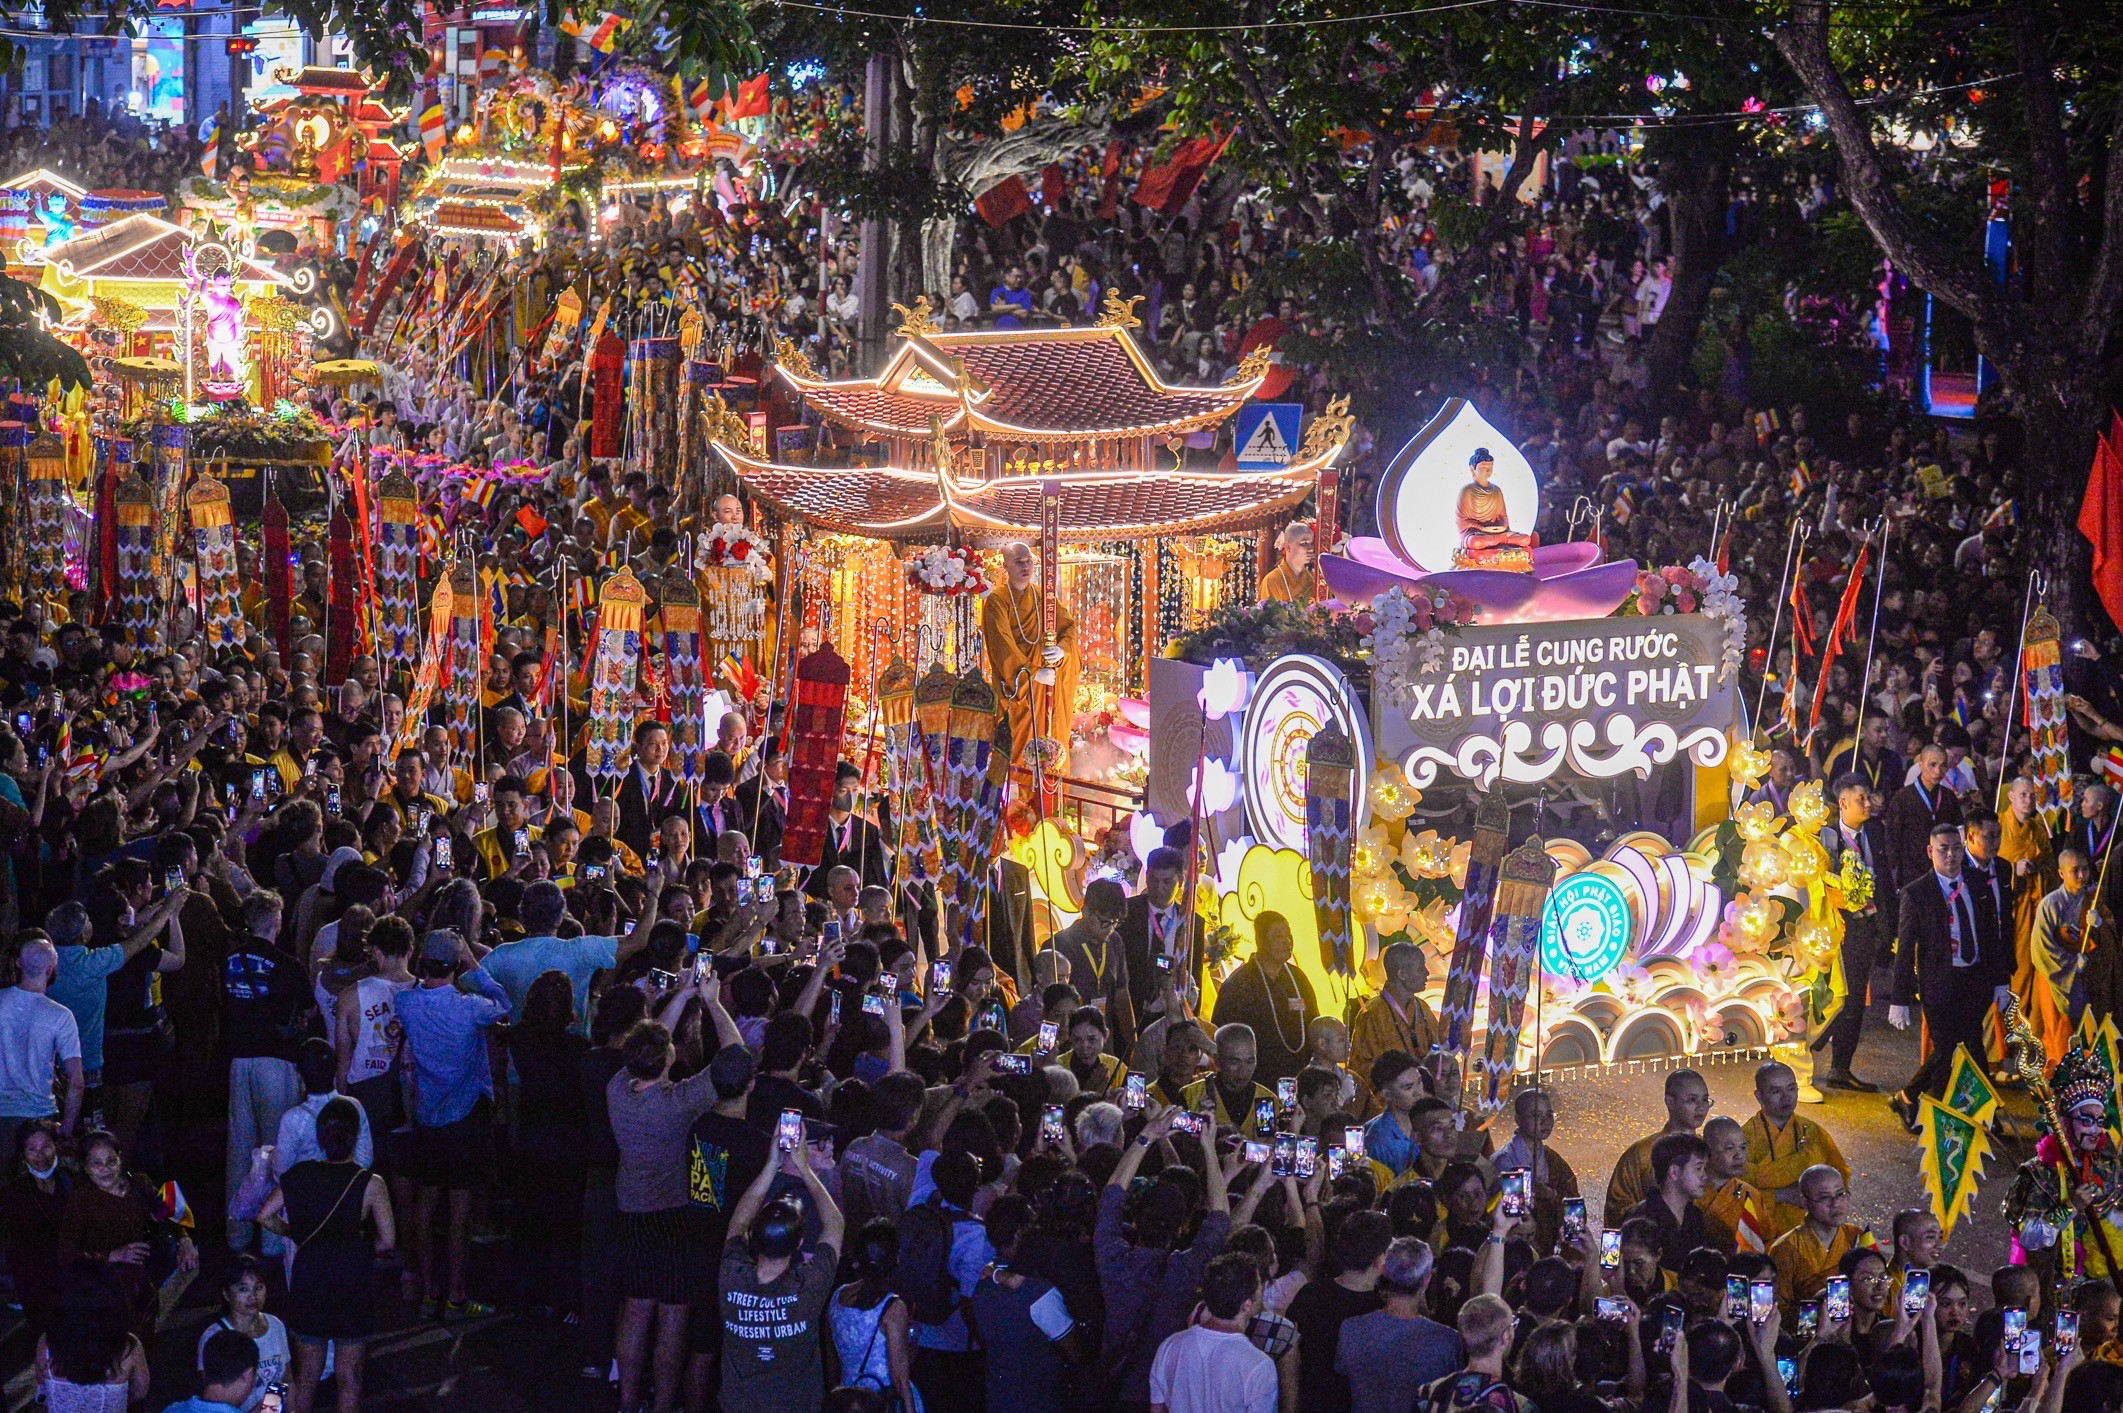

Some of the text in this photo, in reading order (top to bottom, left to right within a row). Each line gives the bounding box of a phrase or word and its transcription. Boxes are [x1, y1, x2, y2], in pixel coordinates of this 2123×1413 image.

[1452, 629, 1679, 675] ĐẠI LỄ CUNG RƯỚC
[1410, 661, 1716, 722] XÁ LỢI ĐỨC PHẬT
[1559, 888, 1580, 909] HỘI
[1584, 954, 1610, 976] NAM
[365, 1002, 390, 1021] SEA
[727, 1291, 758, 1308] STREET
[738, 1308, 787, 1322] LIFESTYLE
[774, 1320, 807, 1338] URBAN
